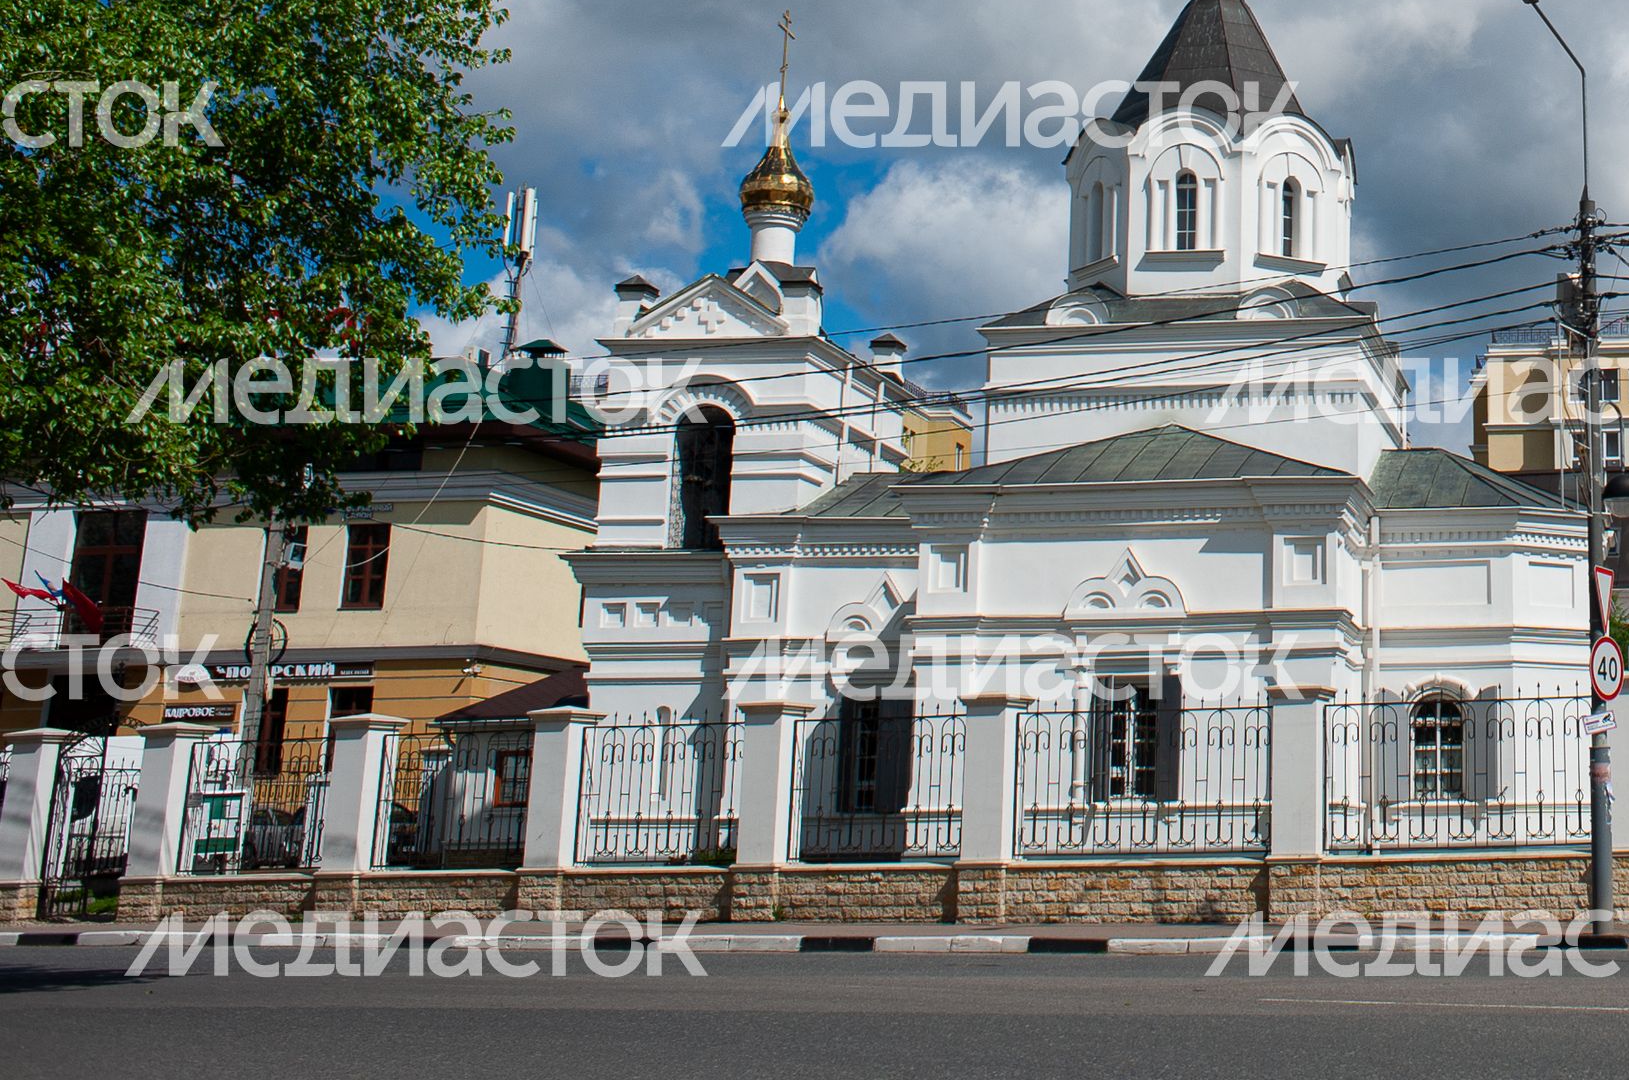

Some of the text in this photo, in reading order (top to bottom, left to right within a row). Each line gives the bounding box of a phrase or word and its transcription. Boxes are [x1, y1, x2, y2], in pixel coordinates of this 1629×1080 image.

[225, 661, 336, 679] ПОРСКИЙ
[1597, 655, 1618, 682] 40
[164, 706, 216, 719] КАДРОВОЕ
